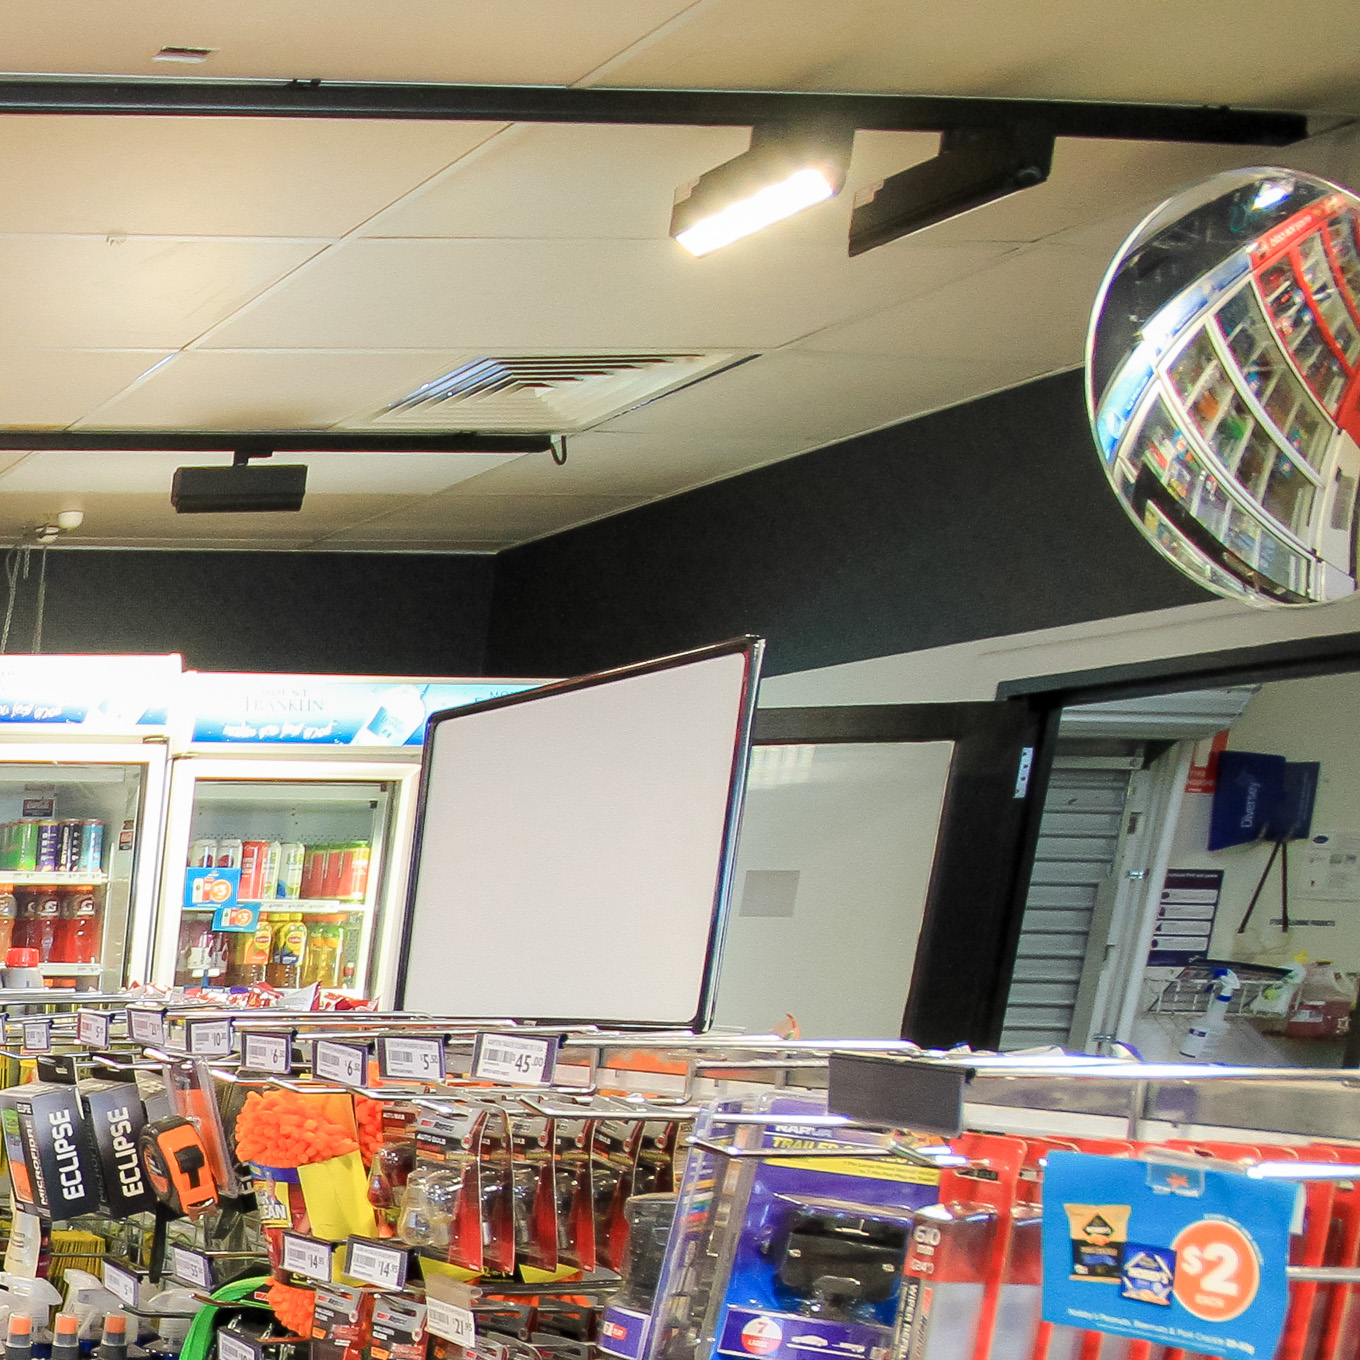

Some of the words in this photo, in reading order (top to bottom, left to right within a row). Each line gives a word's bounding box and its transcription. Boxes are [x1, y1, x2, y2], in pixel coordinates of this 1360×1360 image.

[1239, 779, 1260, 829] Diversey
[511, 1052, 544, 1075] $45.00
[48, 1107, 85, 1201] ECLIPSE
[106, 1105, 145, 1198] ECLIPSE
[307, 1252, 325, 1271] $14.95
[377, 1260, 399, 1278] $14.95
[1181, 1242, 1240, 1298] $2
[756, 1321, 767, 1335] 7
